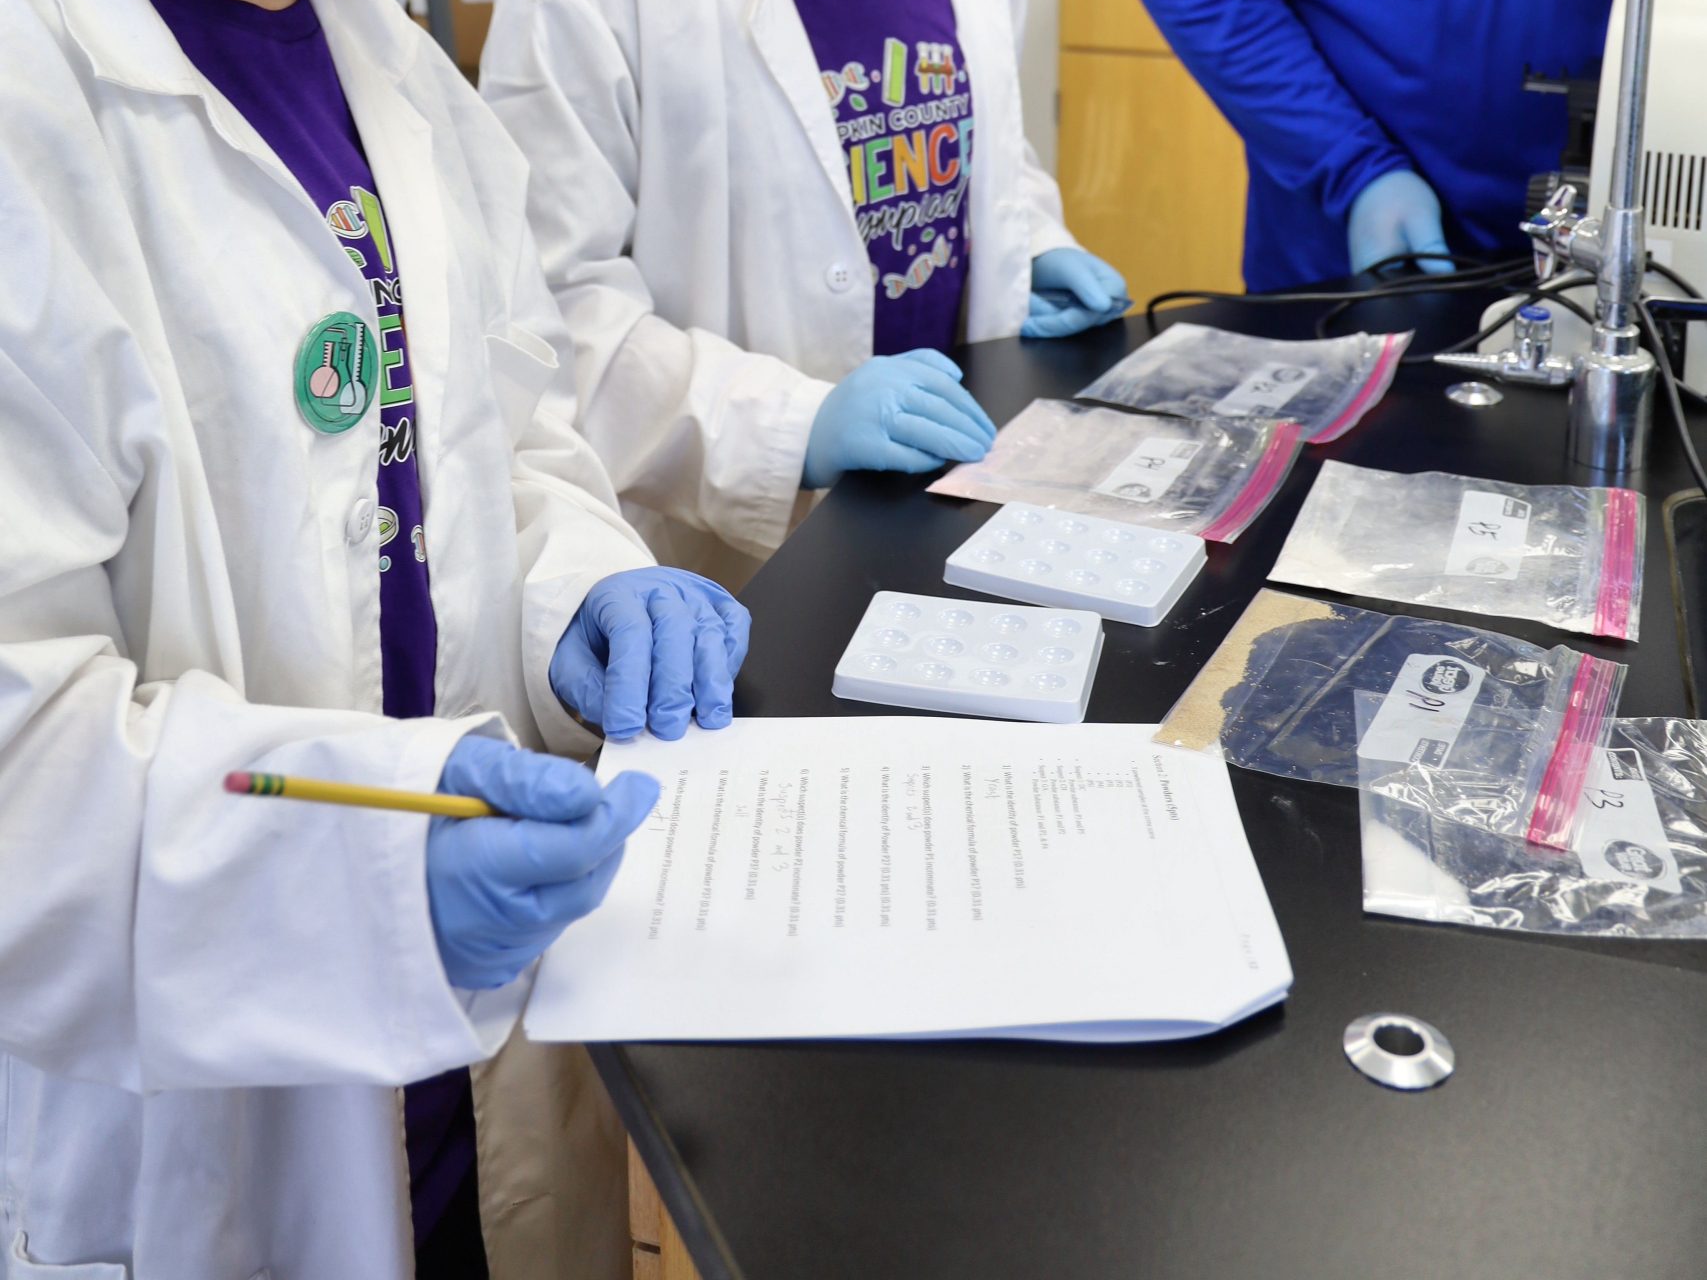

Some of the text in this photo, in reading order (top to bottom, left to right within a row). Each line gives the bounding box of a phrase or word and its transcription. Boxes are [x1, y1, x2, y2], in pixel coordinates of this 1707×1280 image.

[888, 93, 969, 131] COUNTY
[850, 117, 973, 206] IENCE
[675, 778, 688, 794] Which
[717, 778, 728, 793] What
[758, 778, 768, 792] What
[800, 777, 809, 793] Which
[840, 775, 850, 790] What
[881, 774, 891, 788] What
[919, 773, 932, 789] Which
[960, 772, 973, 785] What
[1000, 772, 1014, 785] What
[1160, 780, 1173, 803] Powders
[1583, 786, 1624, 809] P3
[668, 795, 682, 821] suspect(s)
[794, 794, 808, 820] suspect(s)
[920, 790, 933, 816] suspect(s)
[964, 801, 976, 823] chemical
[1007, 800, 1016, 819] identity
[712, 808, 724, 832] chemical
[752, 808, 765, 829] identity
[839, 806, 848, 830] chemical
[880, 804, 890, 824] identity
[921, 817, 934, 830] does
[668, 822, 680, 836] does
[796, 821, 806, 835] does
[966, 825, 977, 847] formula
[1008, 827, 1021, 848] powder
[664, 837, 674, 858] powder
[708, 833, 720, 855] formula
[751, 837, 760, 858] powder
[792, 836, 805, 857] powder
[838, 830, 848, 853] formula
[881, 833, 890, 854] Powder
[922, 831, 935, 852] powder
[771, 862, 789, 872] 3
[968, 855, 979, 877] powder
[1626, 847, 1653, 873] Great
[704, 863, 714, 886] powder
[835, 861, 846, 883] powder
[925, 862, 936, 899] incriminate?
[656, 869, 669, 906] incriminate?
[791, 868, 801, 904] incriminate?
[880, 884, 890, 896] pts)
[1014, 877, 1026, 889] pts)
[744, 888, 755, 900] pts)
[696, 918, 706, 931] pts)
[833, 915, 844, 928] pts)
[880, 914, 889, 927] pts)
[926, 918, 936, 930] pts)
[971, 908, 983, 921] pts)
[648, 925, 658, 940] pts)
[787, 924, 798, 936] pts)
